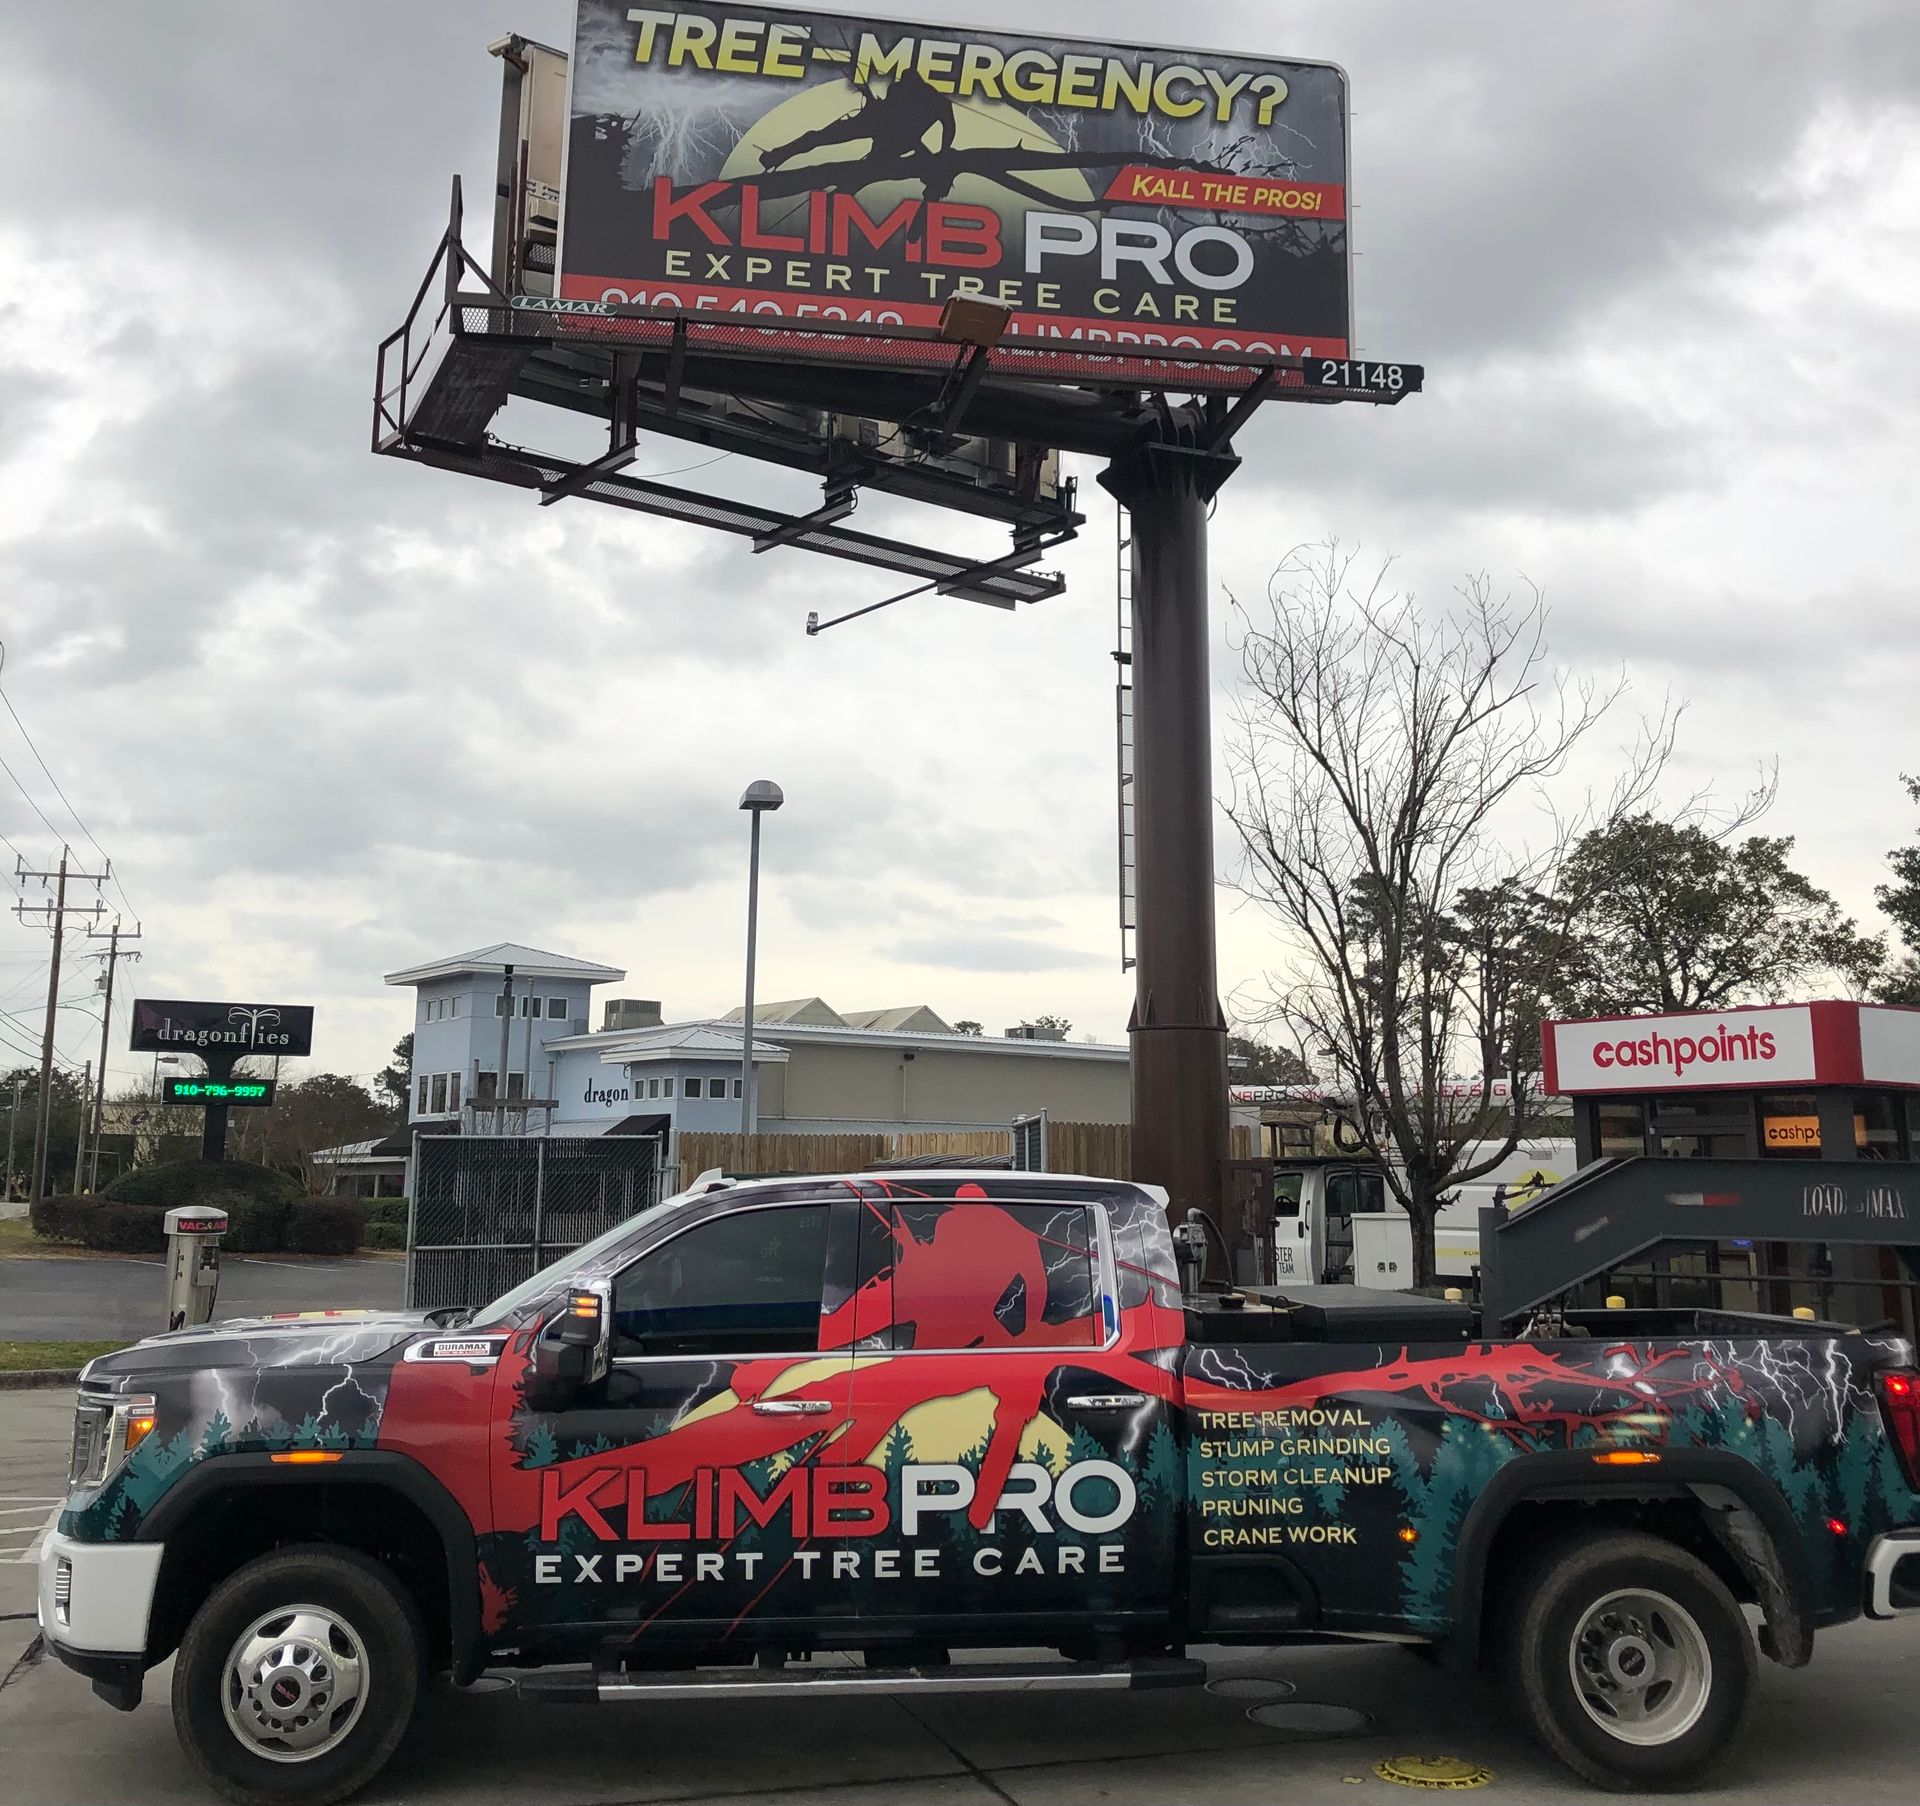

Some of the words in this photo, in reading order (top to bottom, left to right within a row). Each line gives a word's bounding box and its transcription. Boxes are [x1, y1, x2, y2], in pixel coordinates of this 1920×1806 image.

[627, 9, 1288, 125] TREE-MERGENCY?
[1132, 174, 1197, 200] KALL
[1201, 182, 1246, 205] THE
[1253, 187, 1322, 210] PROS!
[652, 176, 1002, 269] KLIMB
[1025, 210, 1254, 290] PRO
[665, 250, 890, 293] EXPERT
[921, 273, 1061, 310] TREE
[1093, 288, 1238, 324] CARE
[519, 297, 608, 314] LAMAR
[1321, 360, 1404, 391] 21148
[1593, 1023, 1776, 1078] cashpoints
[438, 1343, 487, 1351] DURAMAX
[1198, 1411, 1255, 1429] TREE
[1261, 1409, 1371, 1427] REMOVAL
[1200, 1441, 1275, 1458] STUMP
[1280, 1438, 1391, 1456] GRINDING
[1201, 1470, 1278, 1488] STORM
[1283, 1467, 1392, 1485] CLEANUP
[1202, 1498, 1303, 1517] PRUNING
[1204, 1527, 1282, 1546] CRANE
[1287, 1526, 1357, 1544] WORK
[535, 1551, 764, 1584] EXPERT
[794, 1548, 941, 1579] TREE
[973, 1544, 1126, 1576] CARE
